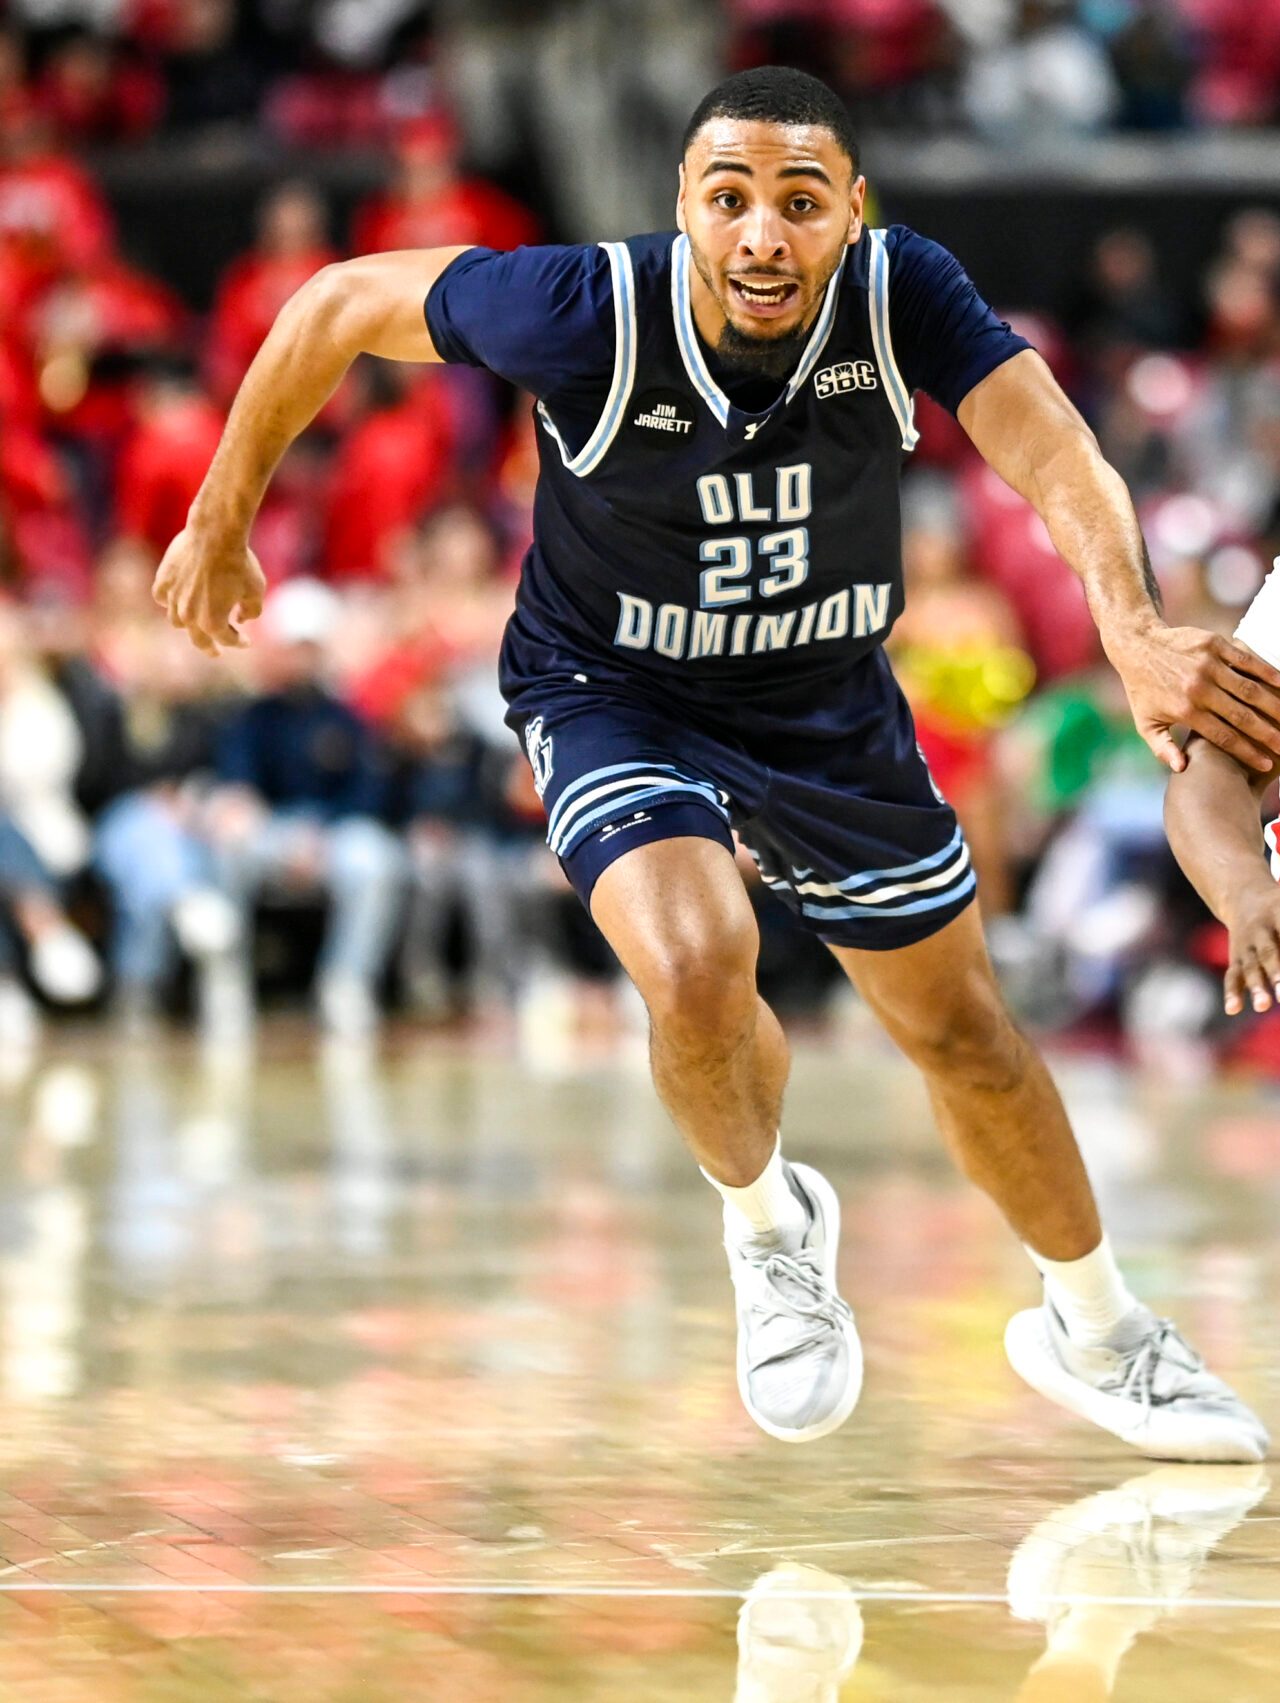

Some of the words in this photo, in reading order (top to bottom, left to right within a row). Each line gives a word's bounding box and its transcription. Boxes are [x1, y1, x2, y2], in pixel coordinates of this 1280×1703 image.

[815, 361, 876, 399] SBC
[634, 414, 692, 434] JARRETT
[652, 404, 676, 418] JIM
[697, 463, 812, 524] OLD
[699, 527, 809, 608] 23
[614, 583, 892, 660] DOMINION
